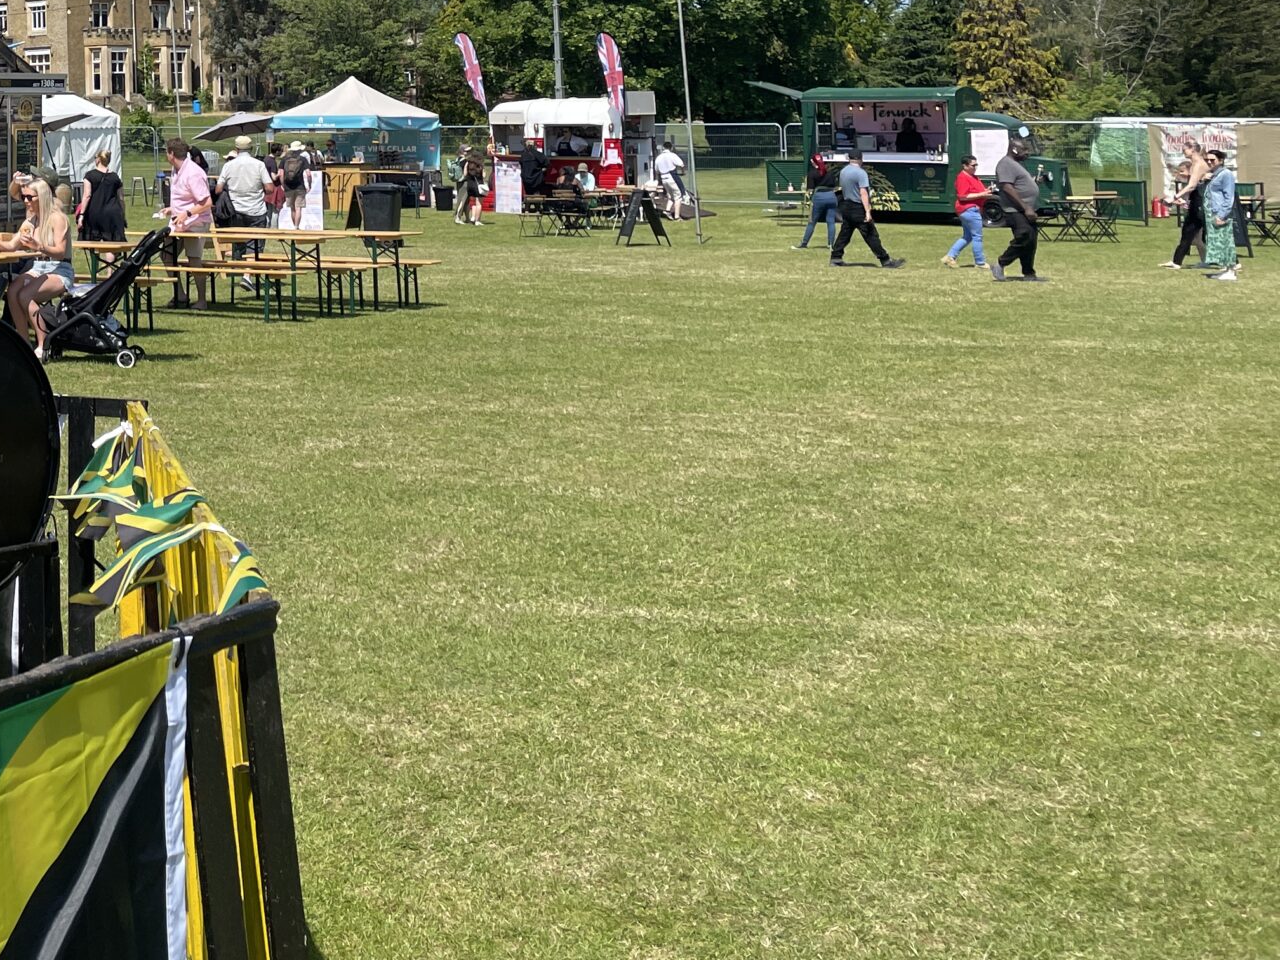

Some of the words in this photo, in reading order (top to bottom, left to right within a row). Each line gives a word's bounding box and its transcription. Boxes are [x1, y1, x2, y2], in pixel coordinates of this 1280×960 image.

[40, 79, 55, 88] 1308
[871, 102, 932, 122] Fenwick
[386, 145, 417, 153] CELLAR
